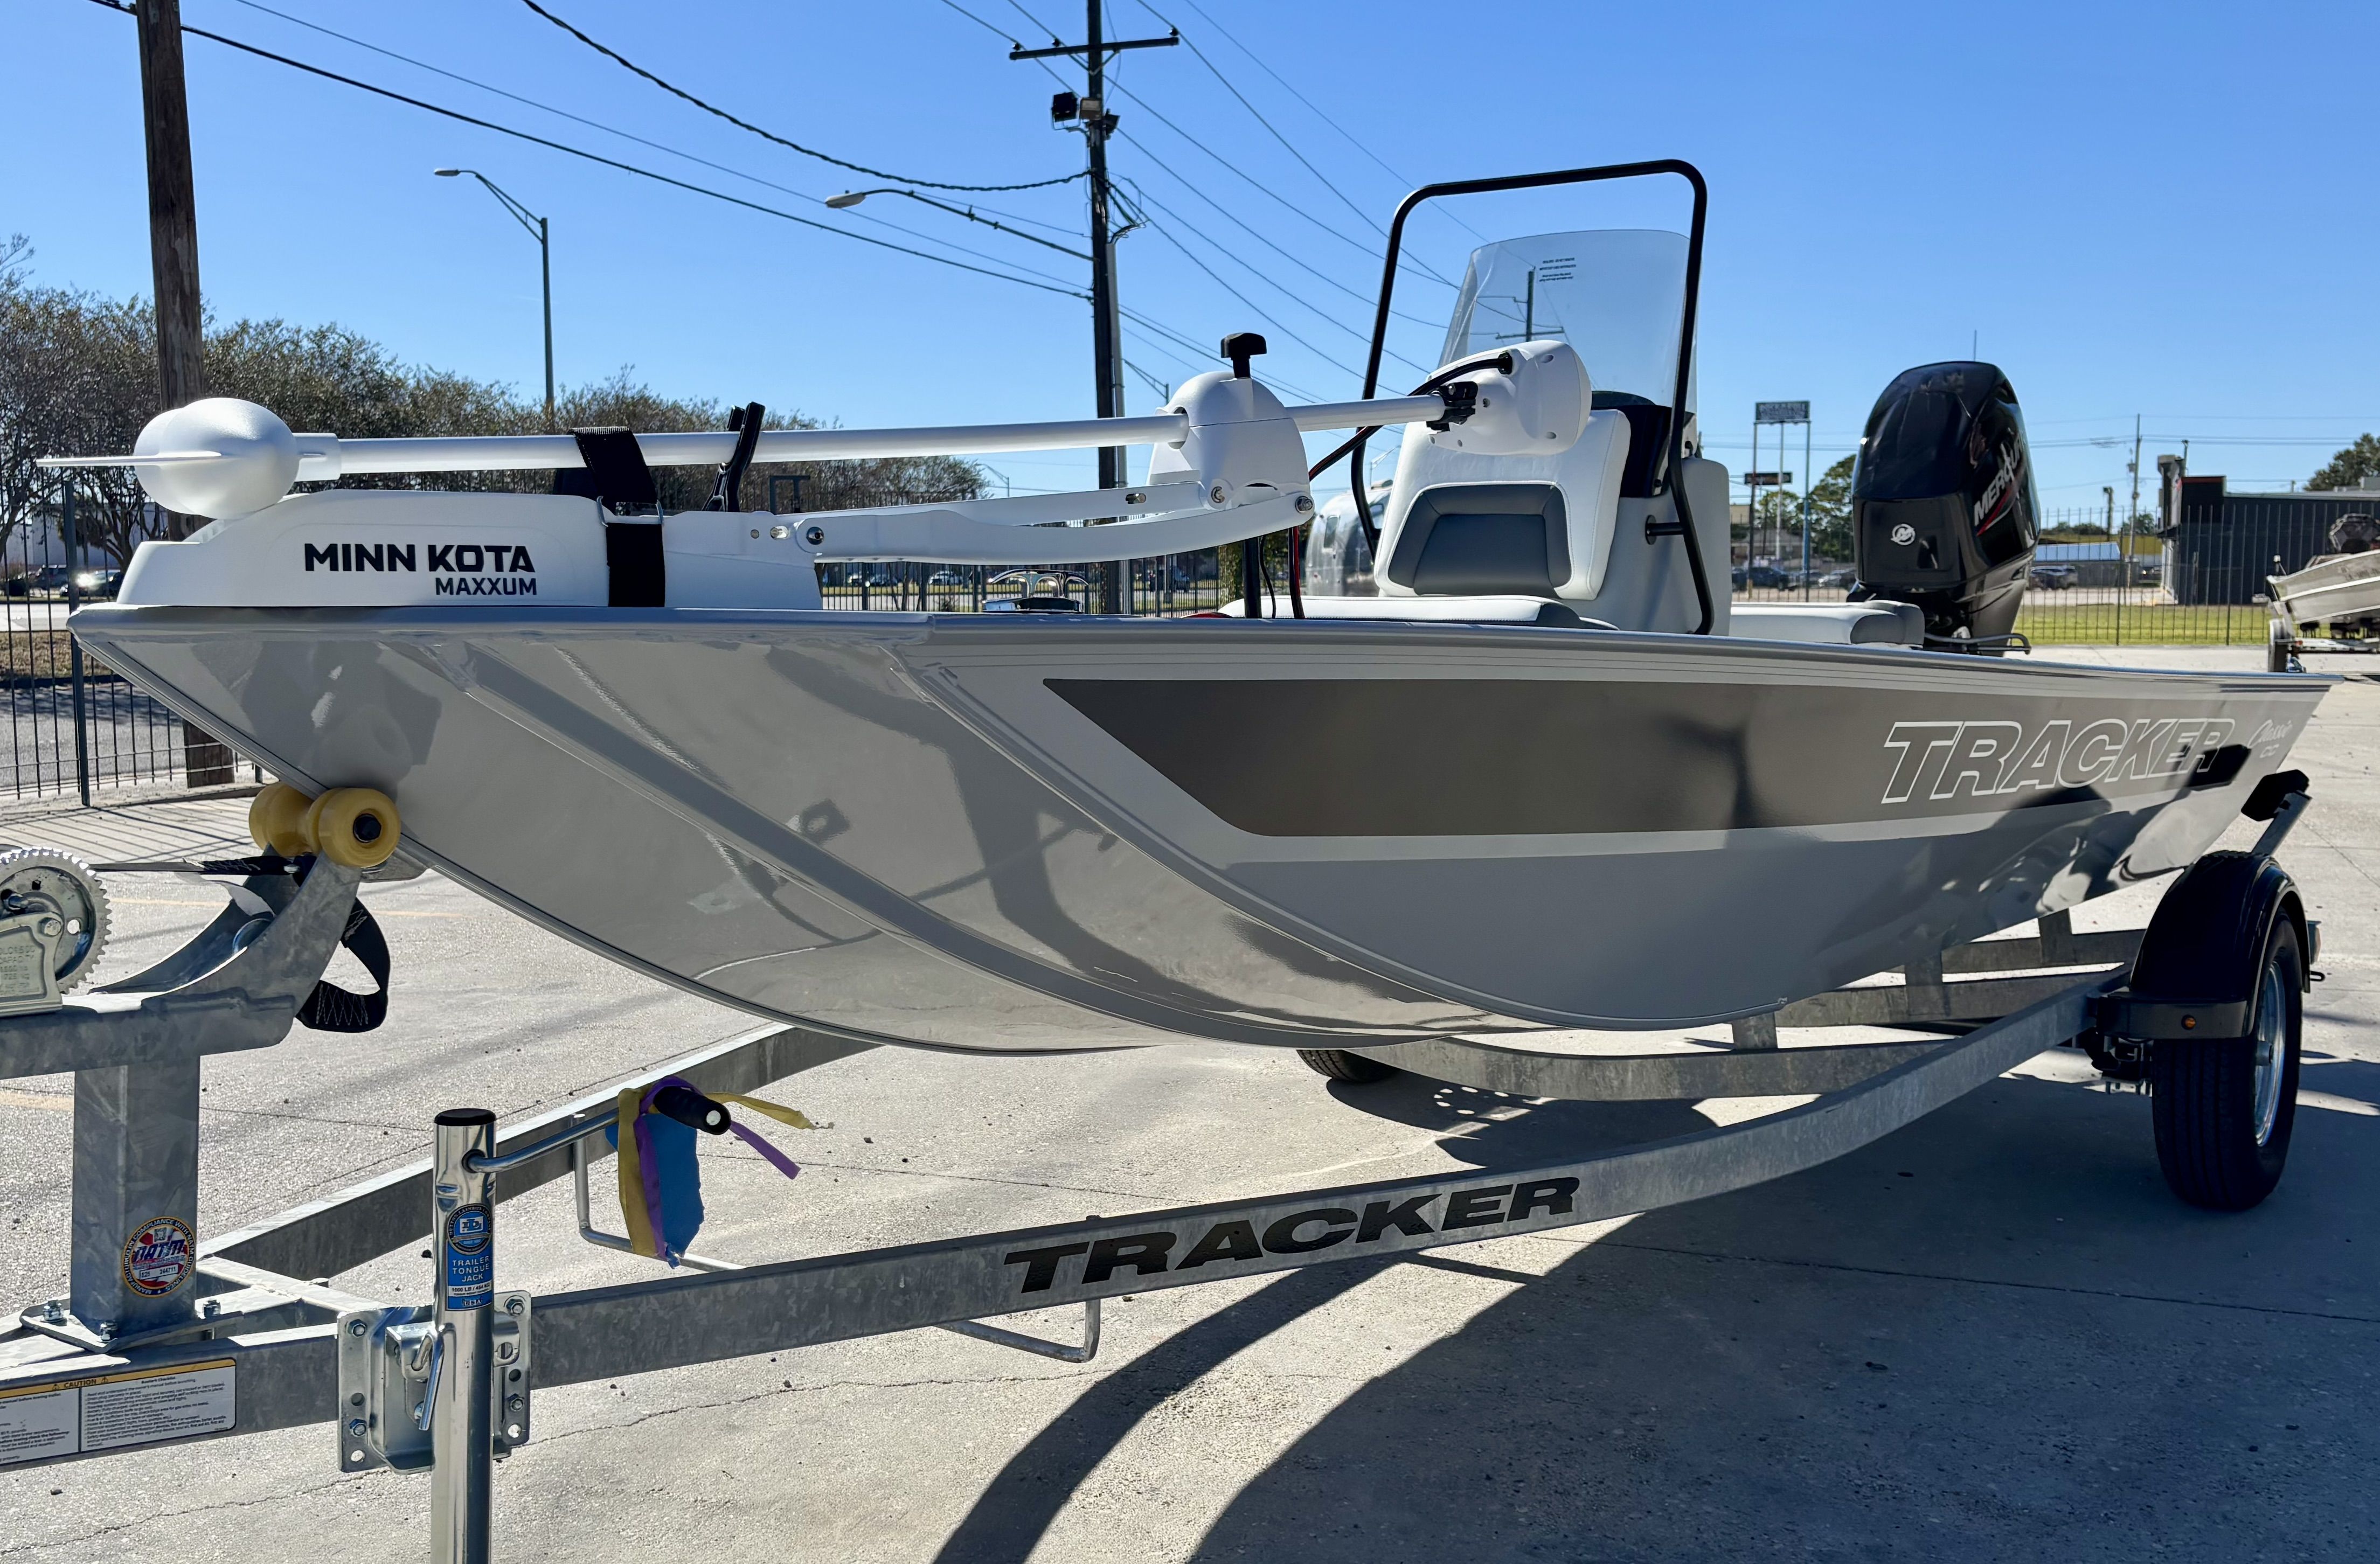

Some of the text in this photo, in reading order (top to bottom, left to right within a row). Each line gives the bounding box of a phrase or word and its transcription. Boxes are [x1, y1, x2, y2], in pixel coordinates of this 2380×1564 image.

[304, 543, 536, 572] MINN KOTA
[435, 578, 537, 595] MAXXUM
[1881, 718, 2235, 804] TRACKER
[134, 1219, 174, 1240] COMPLIANCE
[175, 1221, 189, 1235] WITH
[1004, 1177, 1580, 1294] TRACKER
[453, 1256, 489, 1266] TRAILER
[453, 1263, 489, 1274] TONGUE
[462, 1273, 483, 1282] JACK
[64, 1379, 96, 1388] CAUTION
